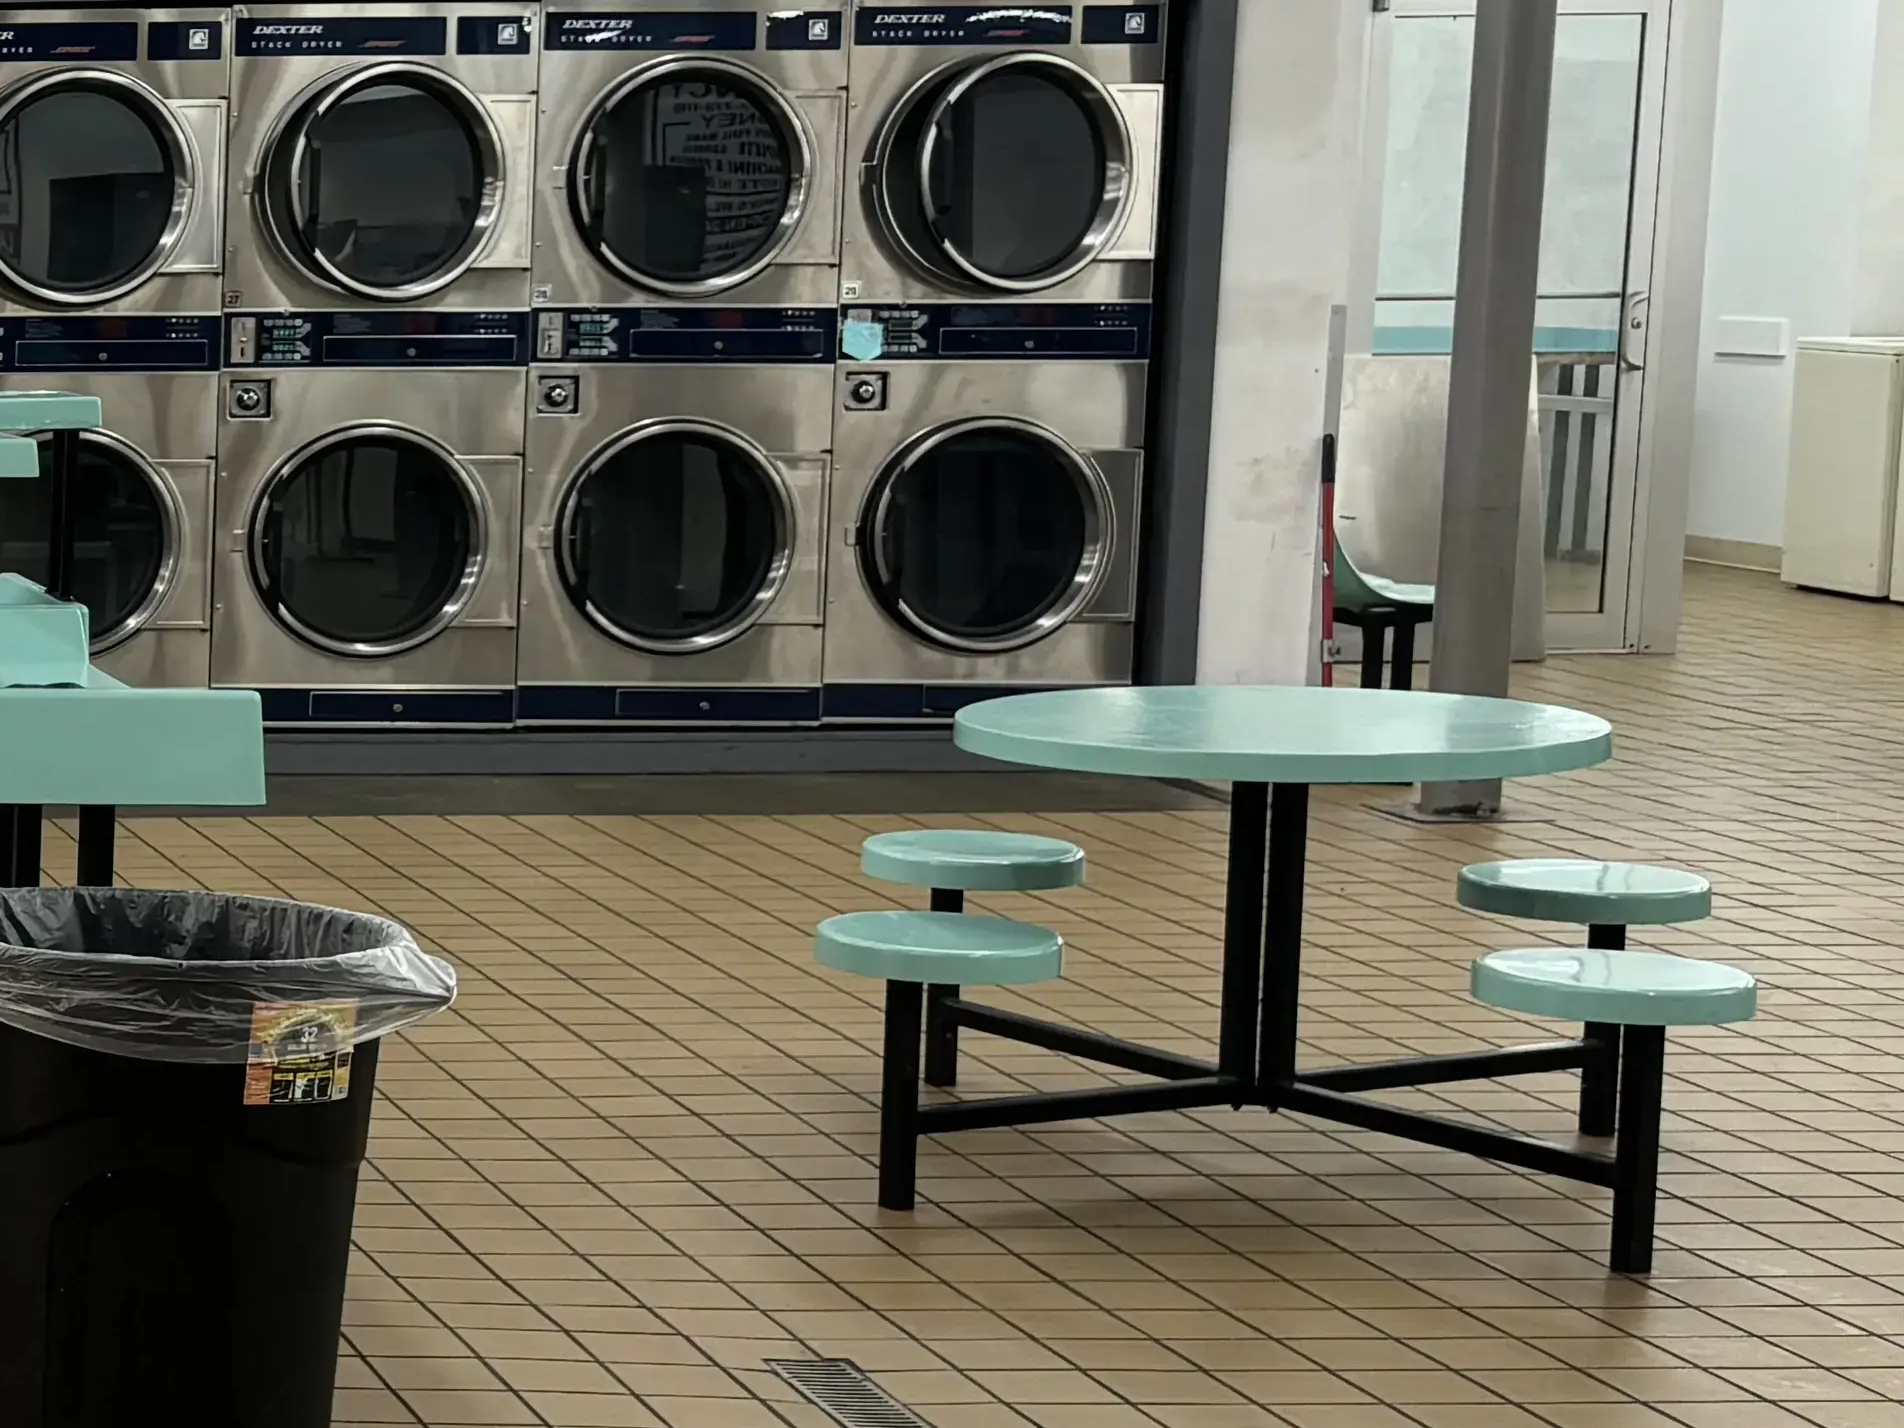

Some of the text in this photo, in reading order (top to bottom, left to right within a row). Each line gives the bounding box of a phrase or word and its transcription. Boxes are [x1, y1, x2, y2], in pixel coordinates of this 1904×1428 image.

[562, 19, 633, 29] DEXTER
[874, 14, 946, 24] DEXTER
[252, 25, 324, 35] DEXTER
[301, 1027, 318, 1042] 32
